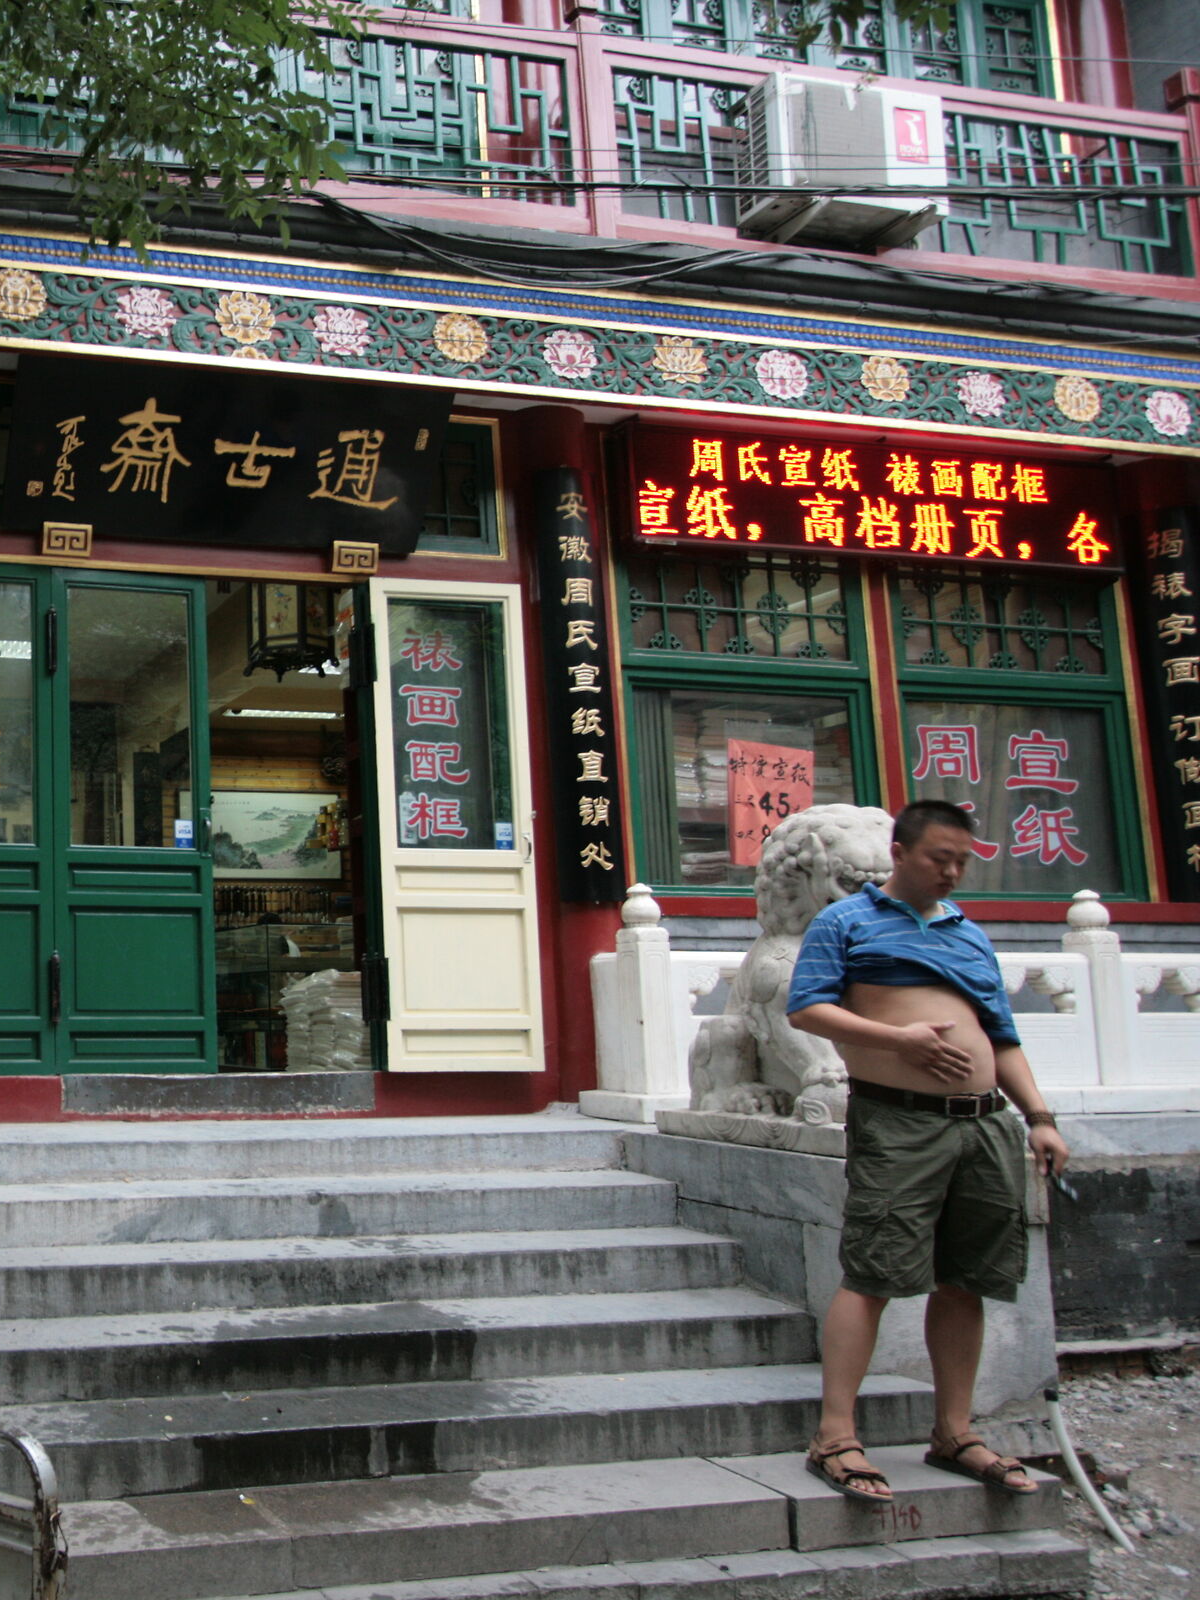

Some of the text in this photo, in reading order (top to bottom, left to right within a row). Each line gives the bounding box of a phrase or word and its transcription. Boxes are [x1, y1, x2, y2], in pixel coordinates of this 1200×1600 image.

[689, 439, 1048, 503] 周氏宣纸 裱画配框
[399, 628, 470, 840] 裱画配框
[556, 492, 614, 871] 安徽周氏宣纸直销处
[1005, 729, 1089, 865] 宣纸
